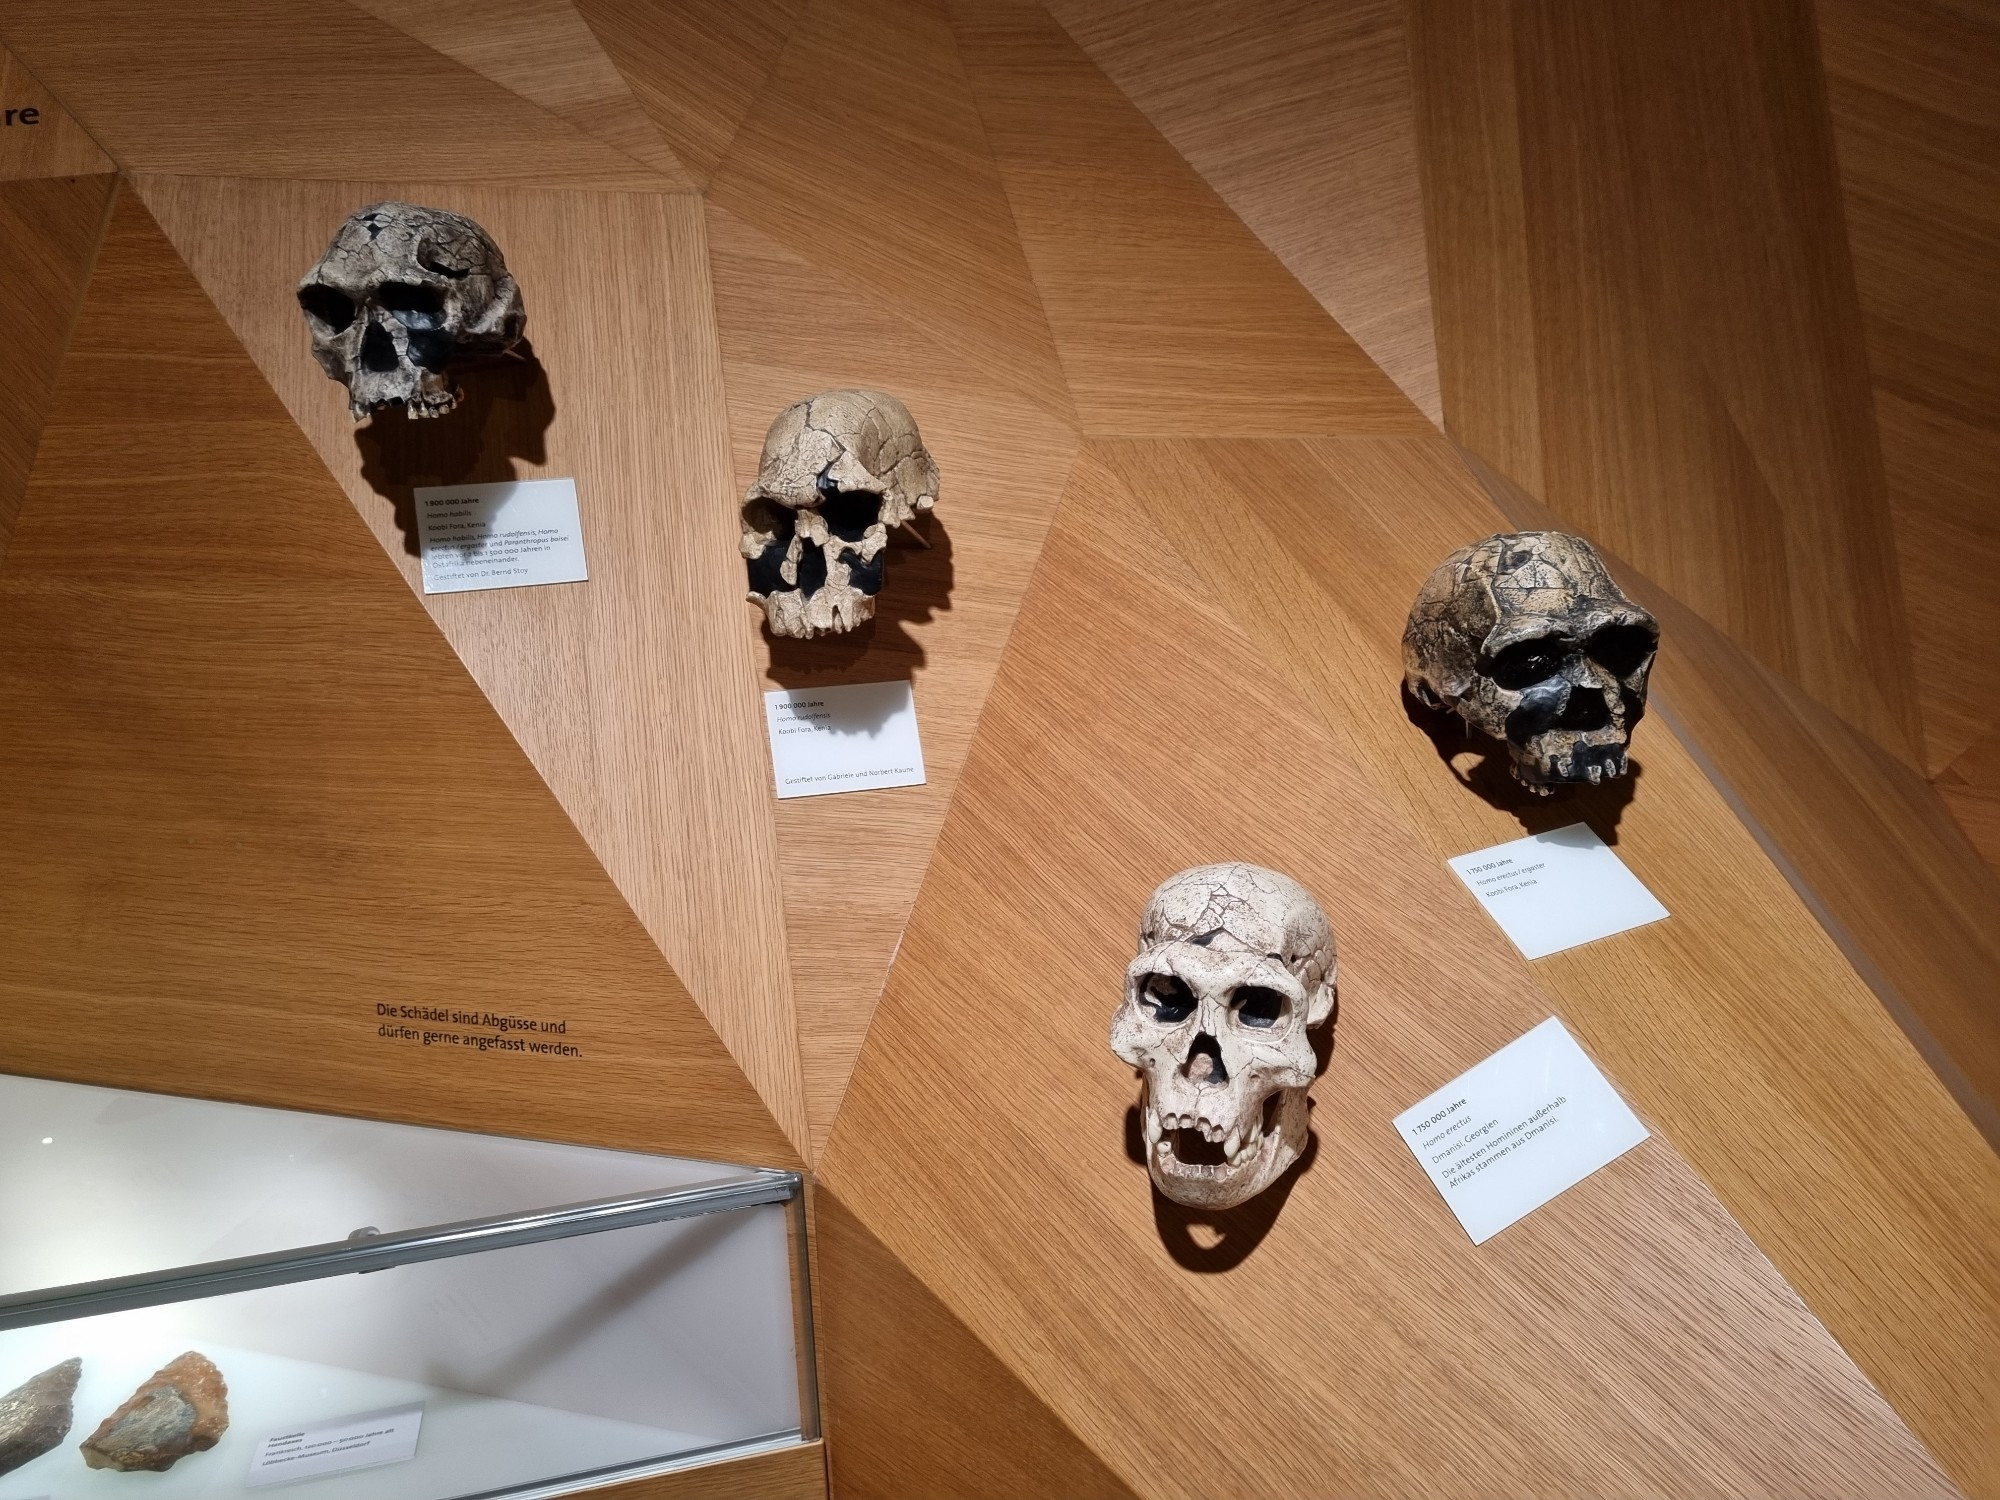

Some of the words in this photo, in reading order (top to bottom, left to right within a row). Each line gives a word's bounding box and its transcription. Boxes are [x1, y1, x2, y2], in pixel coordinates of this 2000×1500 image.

[504, 537, 549, 546] Paranthropus
[431, 552, 453, 560] lebten
[520, 545, 542, 553] Jahren
[466, 556, 519, 566] nebeneinander.
[513, 567, 528, 575] Stoy
[798, 713, 831, 721] rudolfensis
[785, 777, 813, 785] Gestiftet
[828, 772, 854, 780] Gabriele
[869, 768, 893, 776] Norbert
[895, 766, 914, 774] Kaune
[1496, 858, 1513, 867] Jahre
[1477, 877, 1496, 886] Homo
[1497, 870, 1518, 880] erectus
[1522, 863, 1546, 874] ergaster
[1486, 889, 1504, 897] Koobi
[1520, 879, 1537, 889] Kenia
[377, 1003, 398, 1017] Die
[400, 1005, 449, 1022] Schädel
[452, 1011, 478, 1025] sind
[483, 1013, 537, 1032] Abgüsse
[541, 1020, 566, 1034] und
[378, 1024, 419, 1040] dürfen
[423, 1031, 459, 1045] gerne
[463, 1035, 526, 1051] angefasst
[529, 1040, 582, 1057] werden.
[1447, 1098, 1467, 1114] Jahre
[1422, 1132, 1445, 1149] Homo
[1446, 1115, 1472, 1135] erectus
[1442, 1167, 1455, 1179] Die
[1456, 1148, 1486, 1170] ältesten
[1487, 1122, 1528, 1151] Homininen
[1528, 1096, 1567, 1124] außerhalb
[1432, 1141, 1466, 1164] Dmanisi,
[1464, 1119, 1499, 1144] Georgien
[1449, 1168, 1475, 1189] Afrikas
[1475, 1146, 1511, 1172] stammen
[1511, 1136, 1525, 1149] aus
[1525, 1115, 1559, 1140] Dmanisi.
